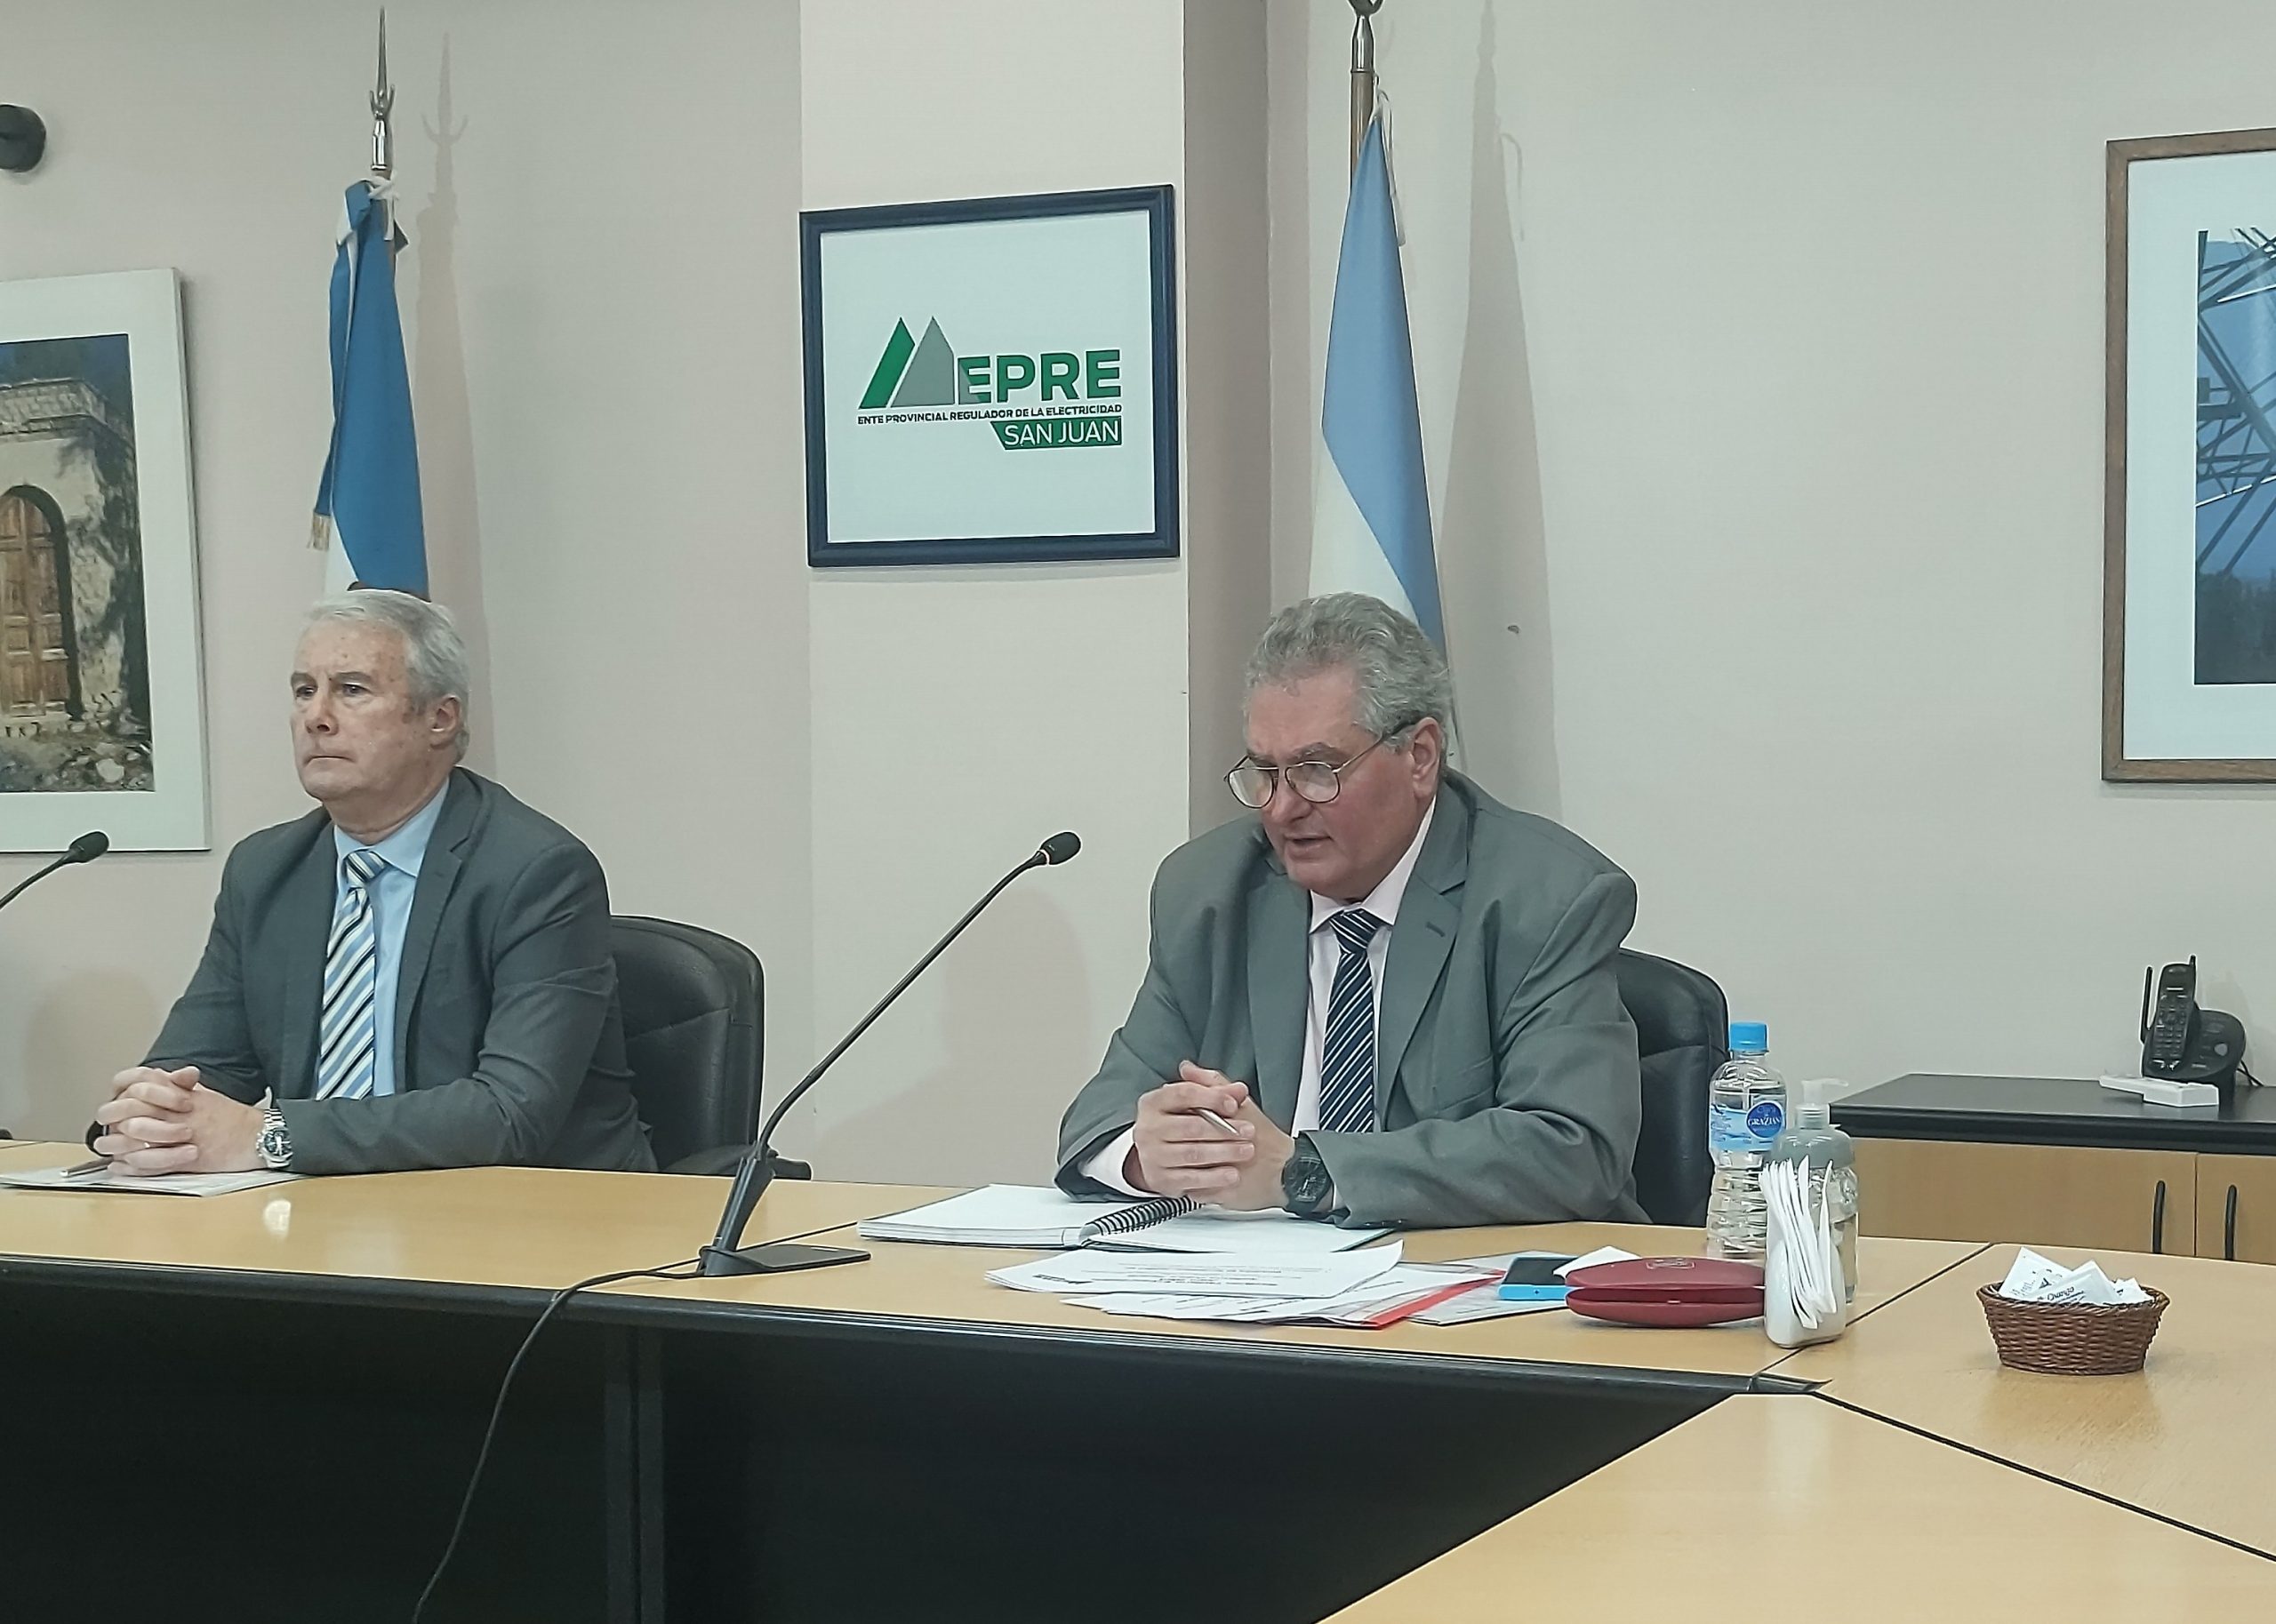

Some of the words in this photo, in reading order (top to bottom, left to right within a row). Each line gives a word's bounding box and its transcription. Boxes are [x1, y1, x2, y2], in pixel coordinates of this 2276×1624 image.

[958, 349, 1121, 405] EPRE
[858, 415, 884, 425] ENTE
[886, 412, 949, 424] PROVINCIAL
[950, 409, 1013, 420] REGULADOR
[1015, 408, 1029, 418] DE
[1030, 407, 1045, 417] LA
[1046, 404, 1122, 416] ELECTRICIDAD
[1004, 422, 1053, 445] SAN
[1058, 420, 1118, 444] JUAN
